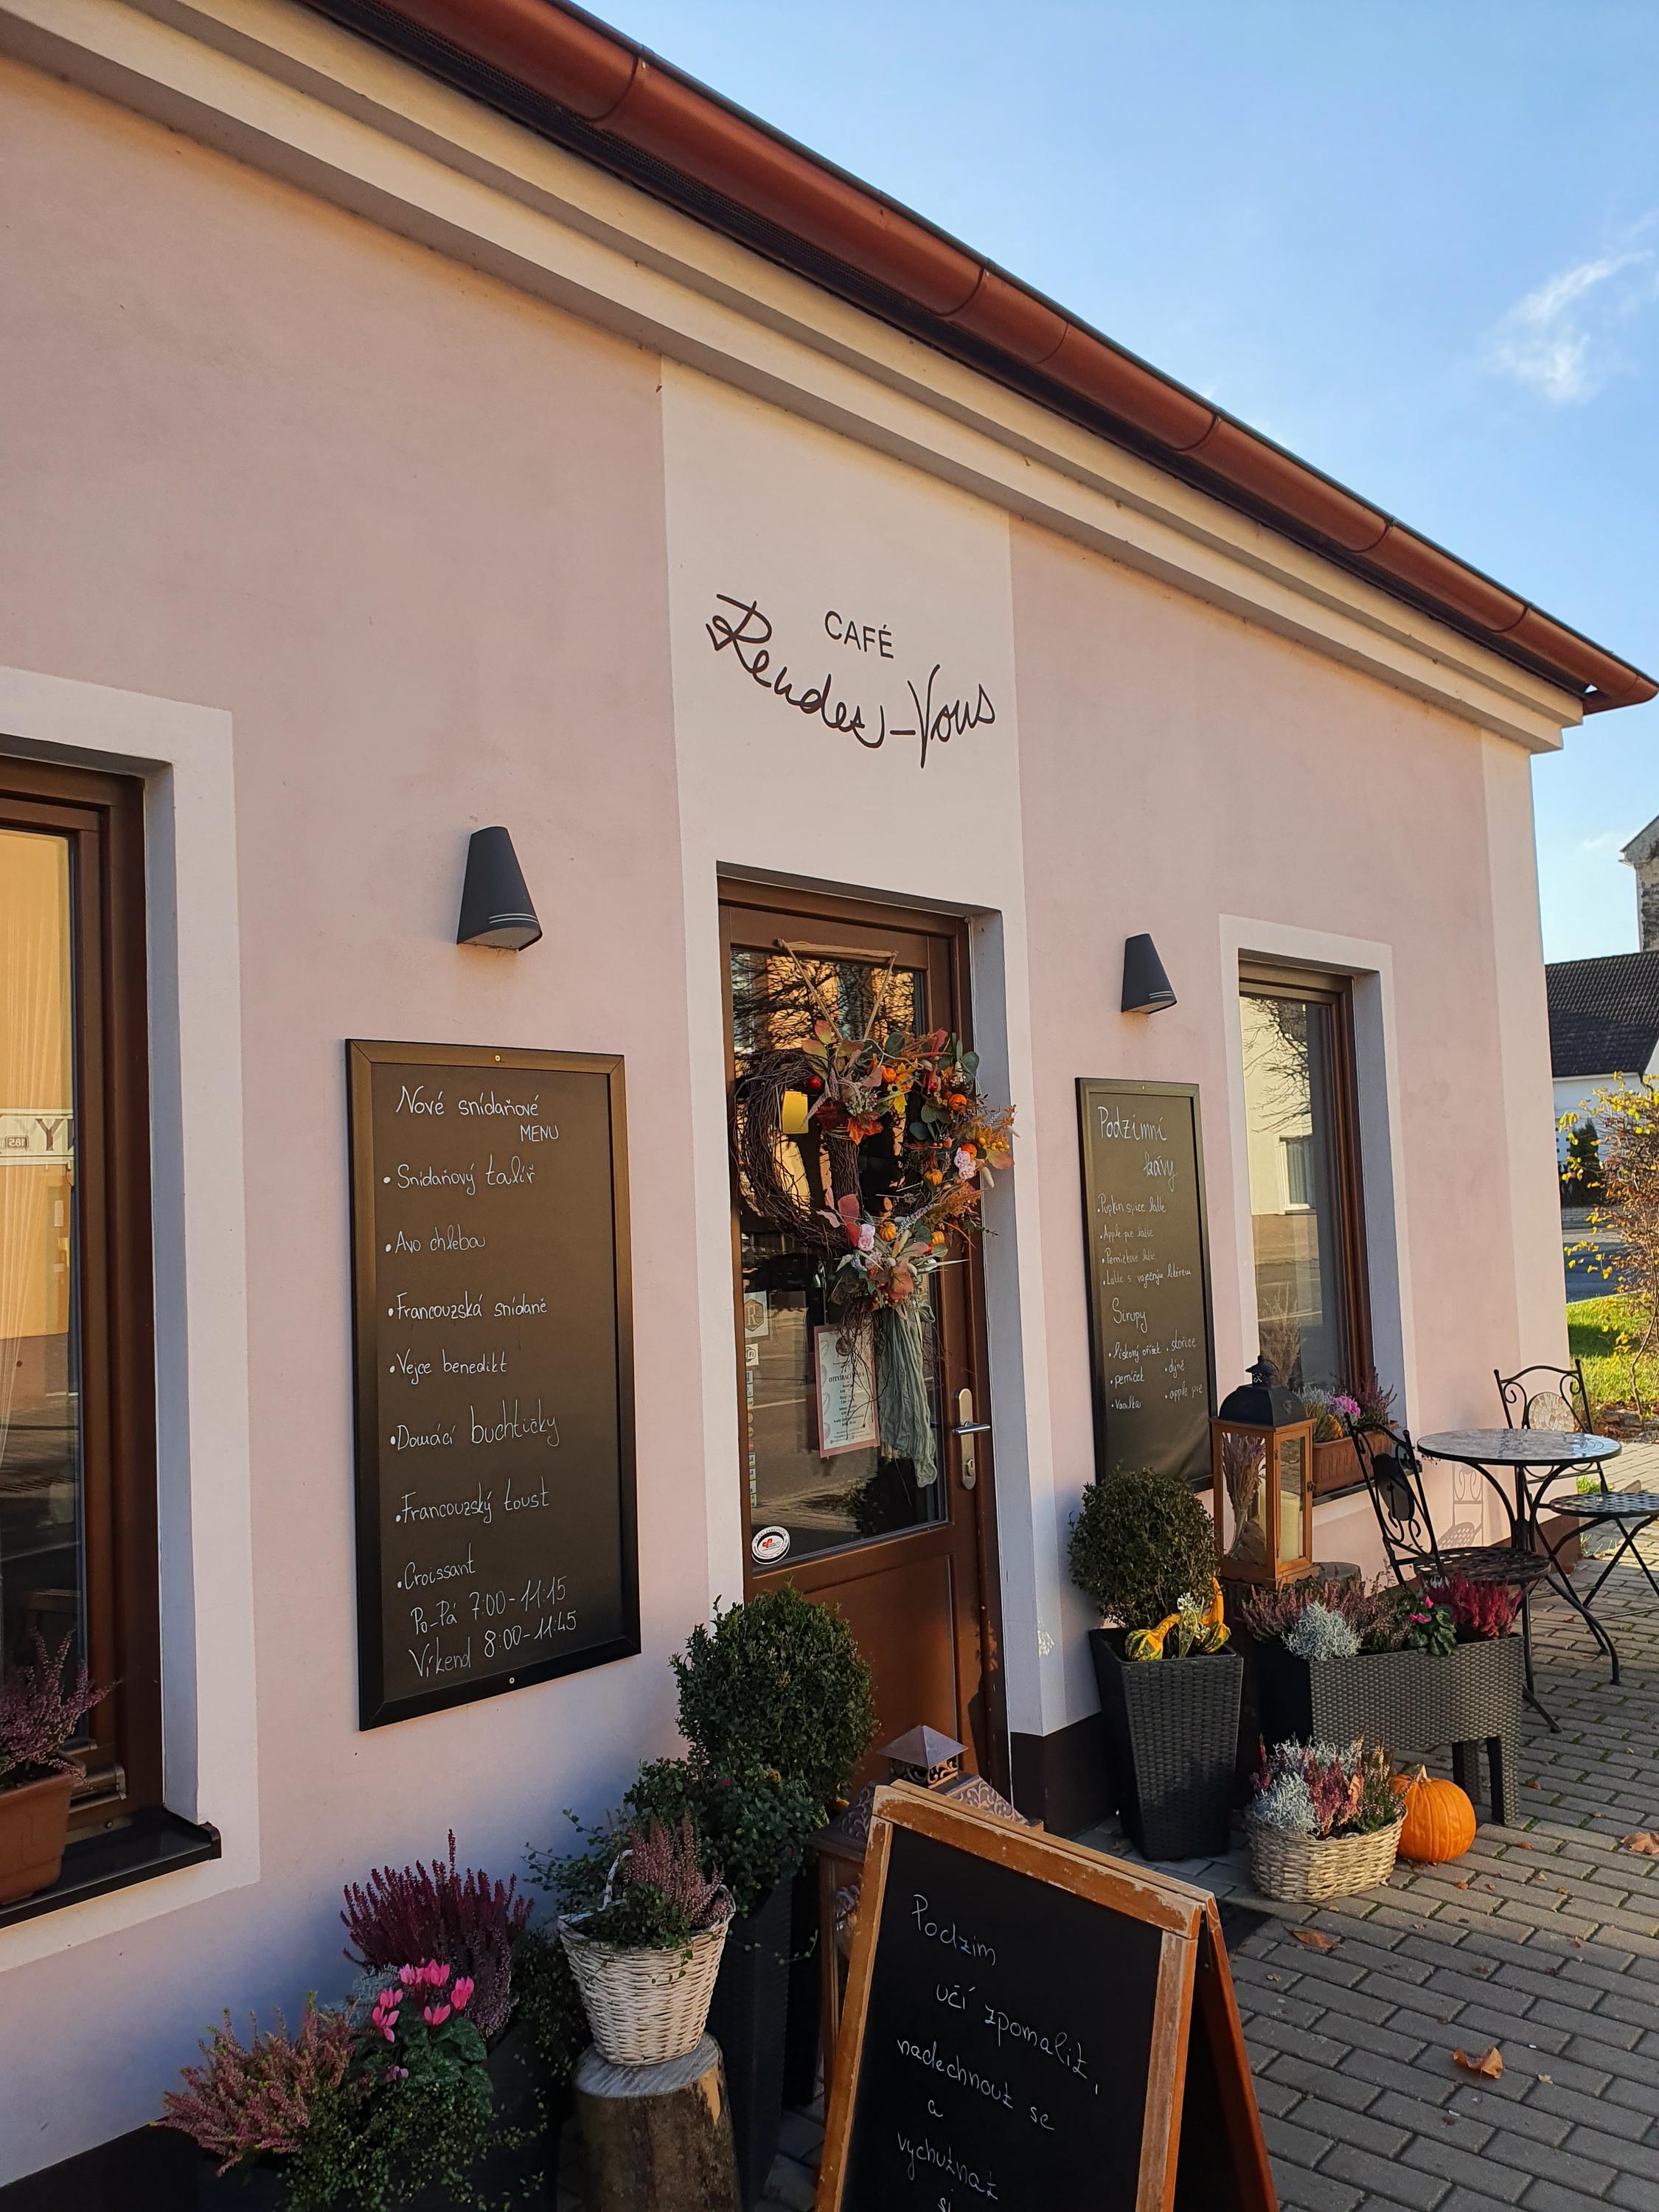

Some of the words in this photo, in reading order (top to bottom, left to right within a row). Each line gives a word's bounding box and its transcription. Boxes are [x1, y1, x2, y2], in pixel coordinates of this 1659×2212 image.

[824, 609, 894, 659] CAFÉ
[395, 1085, 445, 1115] Nové
[457, 1091, 540, 1117] snídaňové
[520, 1124, 560, 1143] MENU
[1097, 1106, 1167, 1141] Podzimní
[397, 1163, 476, 1196] Snídaňový
[485, 1153, 537, 1186] talíř
[1144, 1151, 1176, 1192] kávy
[394, 1230, 422, 1254] Avo
[429, 1224, 487, 1251] chleba
[396, 1291, 483, 1321] Francouzská
[493, 1293, 548, 1318] snídaně
[1112, 1297, 1148, 1334] Sirupy
[396, 1349, 432, 1385] Vejce
[442, 1349, 507, 1374] benedikt
[396, 1423, 456, 1451] Domácí
[470, 1398, 560, 1447] buchtičky
[401, 1481, 493, 1524] Francouzský
[504, 1475, 550, 1512] toust
[403, 1542, 476, 1590] Croissant
[408, 1637, 472, 1678] Víkend
[911, 1893, 996, 1966] Podzim
[935, 1983, 976, 2009] učí
[897, 2039, 1015, 2110] nadechnout
[1029, 2104, 1055, 2131] se
[928, 2099, 944, 2118] a
